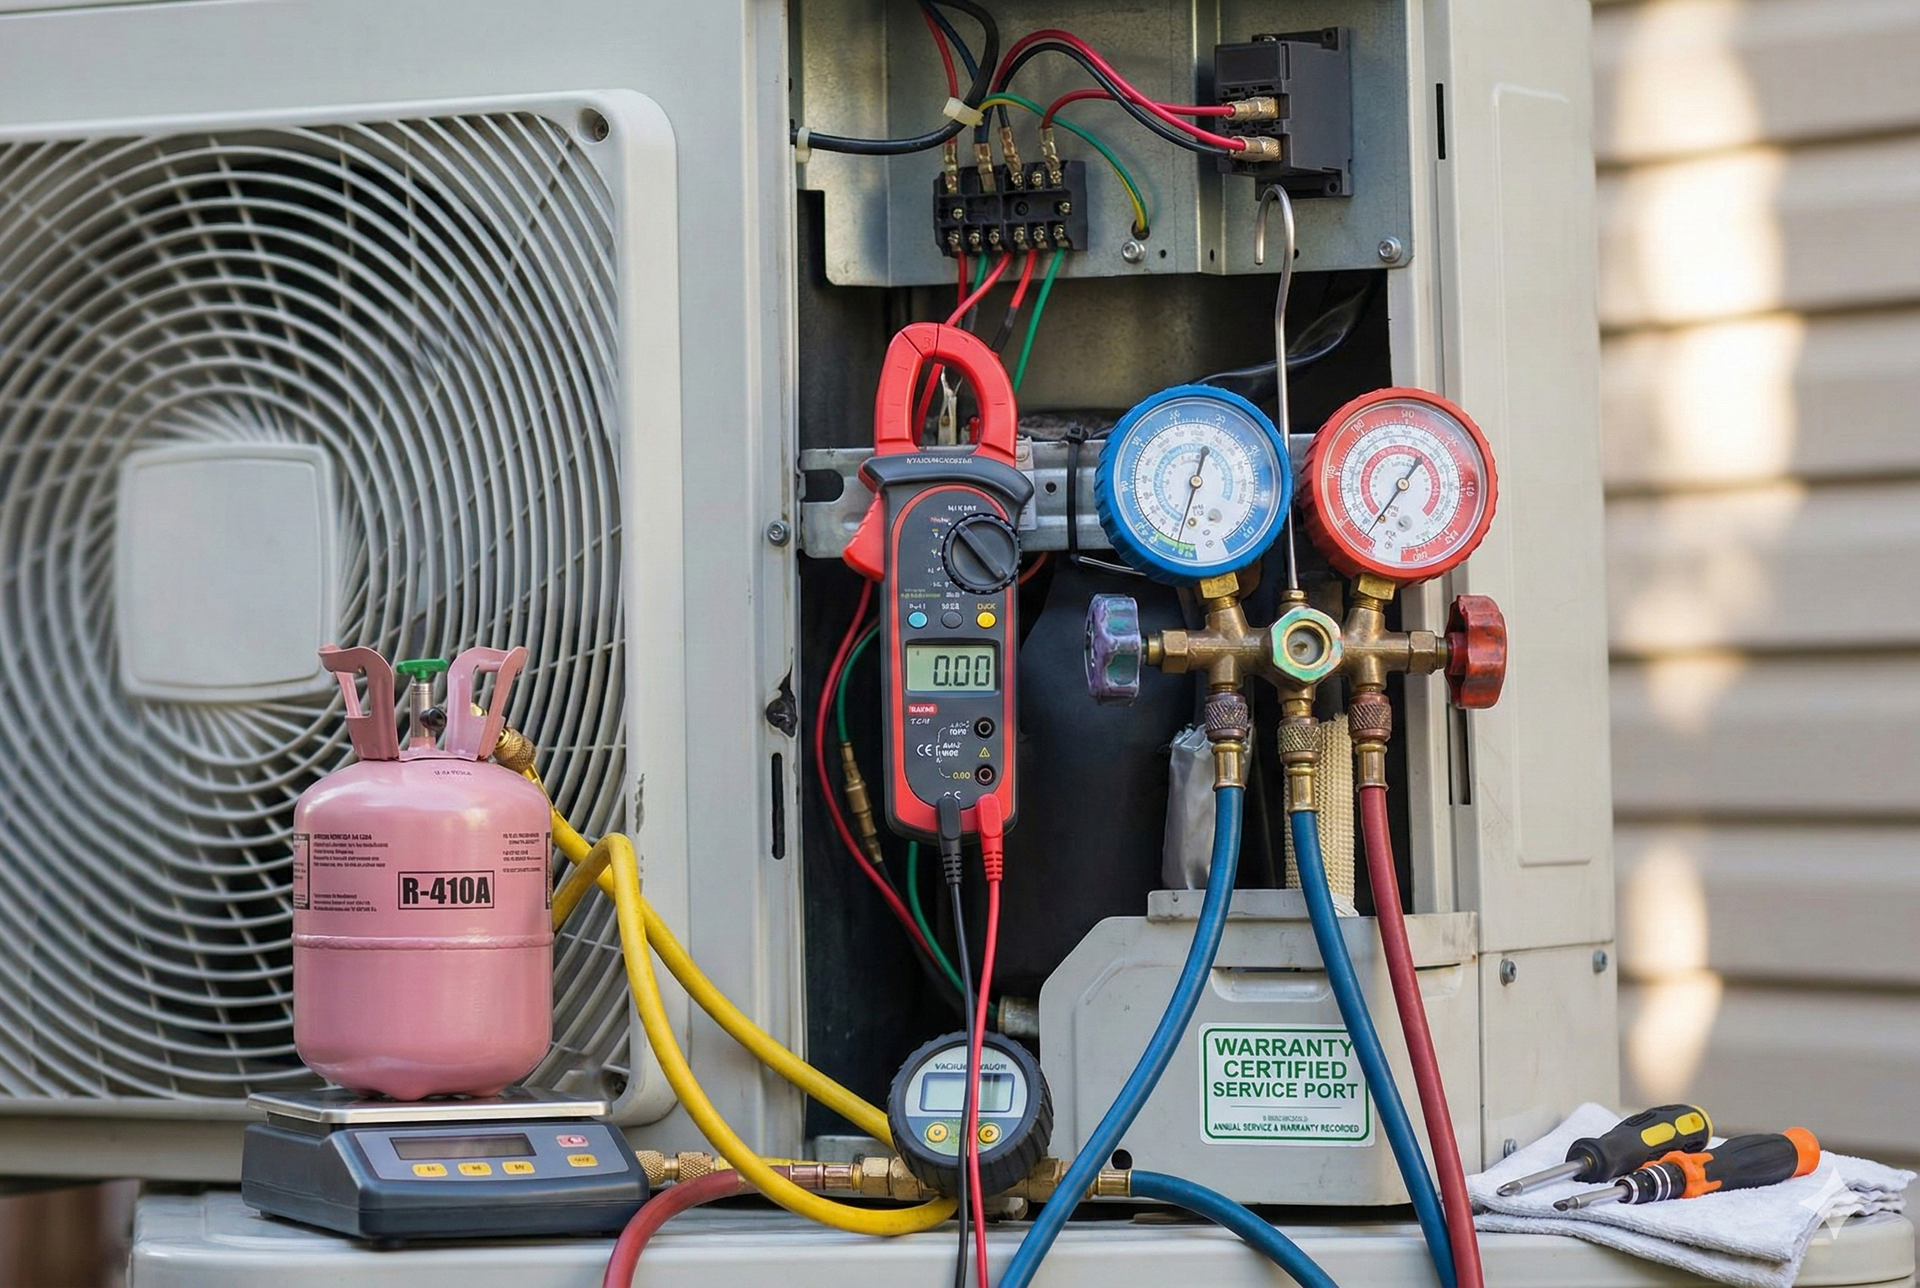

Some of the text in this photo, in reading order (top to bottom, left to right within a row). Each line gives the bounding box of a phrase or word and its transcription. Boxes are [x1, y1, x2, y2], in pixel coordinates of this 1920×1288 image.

[933, 655, 991, 687] 0.00
[402, 876, 491, 905] R-410A
[1214, 1038, 1354, 1057] WARRANTY
[1223, 1060, 1347, 1079] CERTIFIED
[1213, 1081, 1358, 1099] SERVICE PORT
